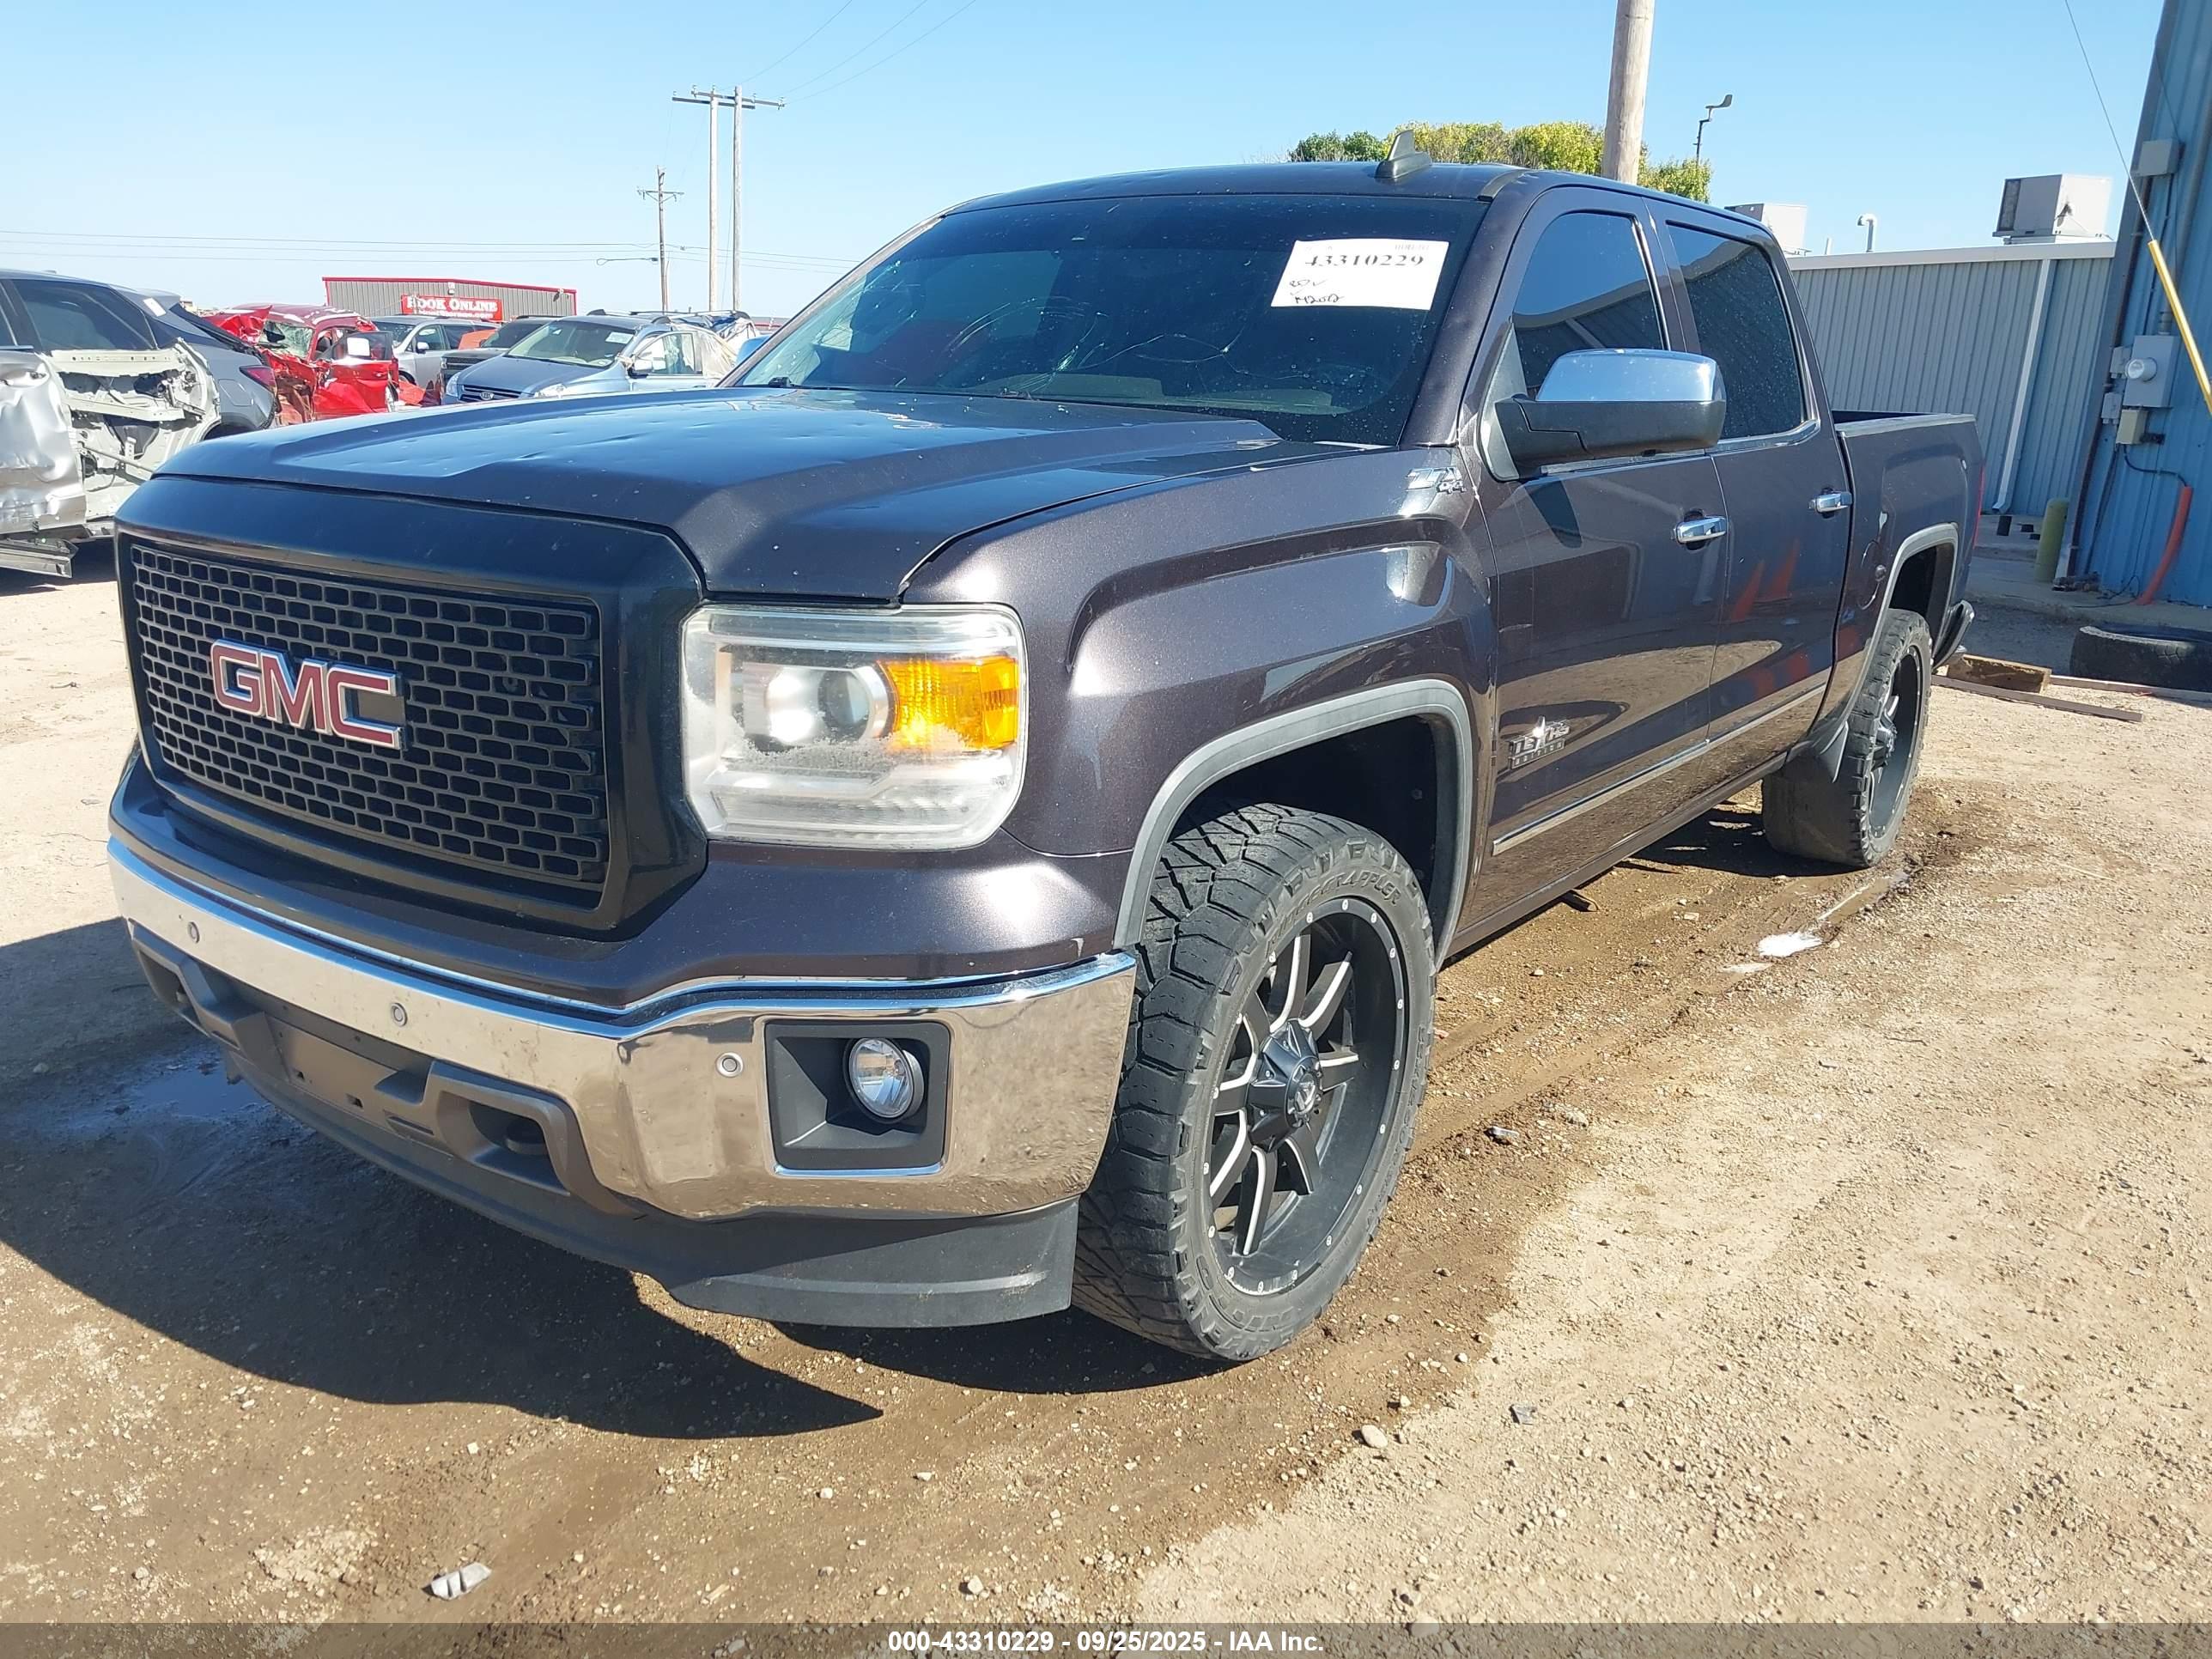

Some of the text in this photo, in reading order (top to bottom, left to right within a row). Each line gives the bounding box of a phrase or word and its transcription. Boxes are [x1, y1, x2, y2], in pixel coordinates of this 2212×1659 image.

[1304, 254, 1424, 267] 43310229
[448, 298, 498, 312] ONLINE
[210, 638, 404, 750] GMC
